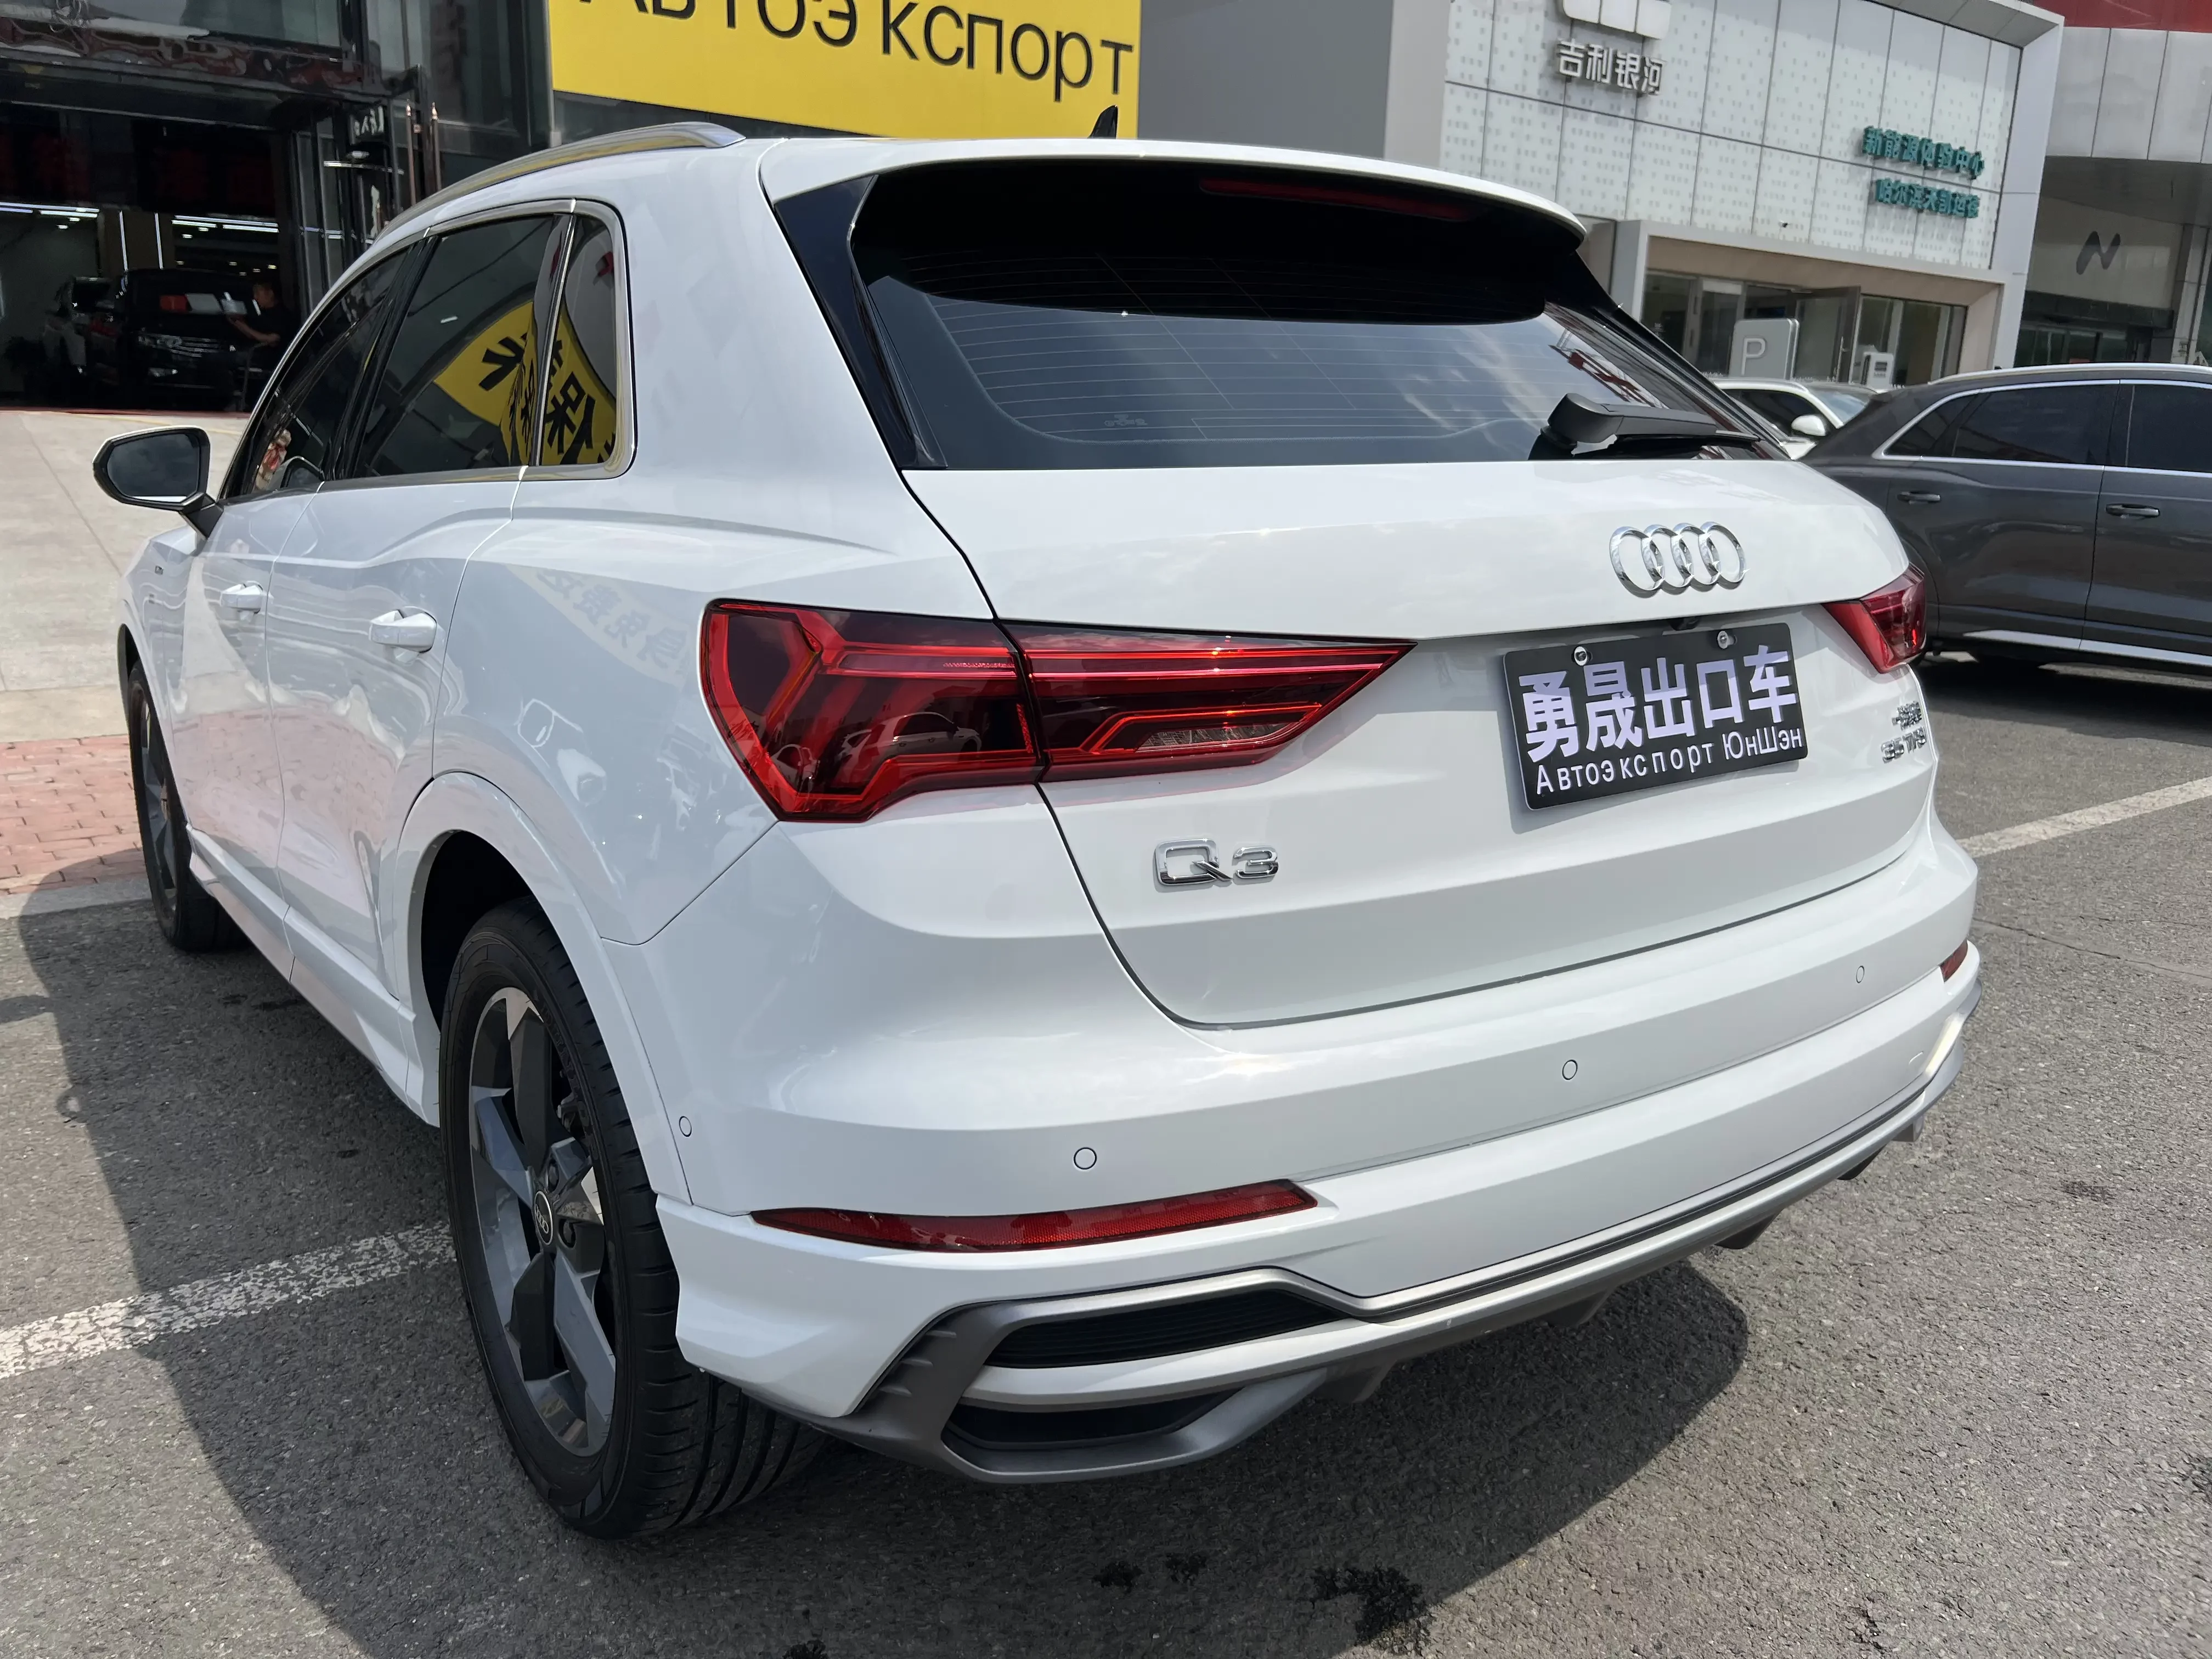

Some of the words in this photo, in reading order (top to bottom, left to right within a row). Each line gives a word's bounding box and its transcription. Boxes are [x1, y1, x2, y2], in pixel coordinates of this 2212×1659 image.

[1559, 38, 1666, 95] 吉利银河
[1741, 337, 1767, 376] P
[1518, 645, 1798, 763] 勇晟出口车
[1154, 838, 1279, 887] Q3
